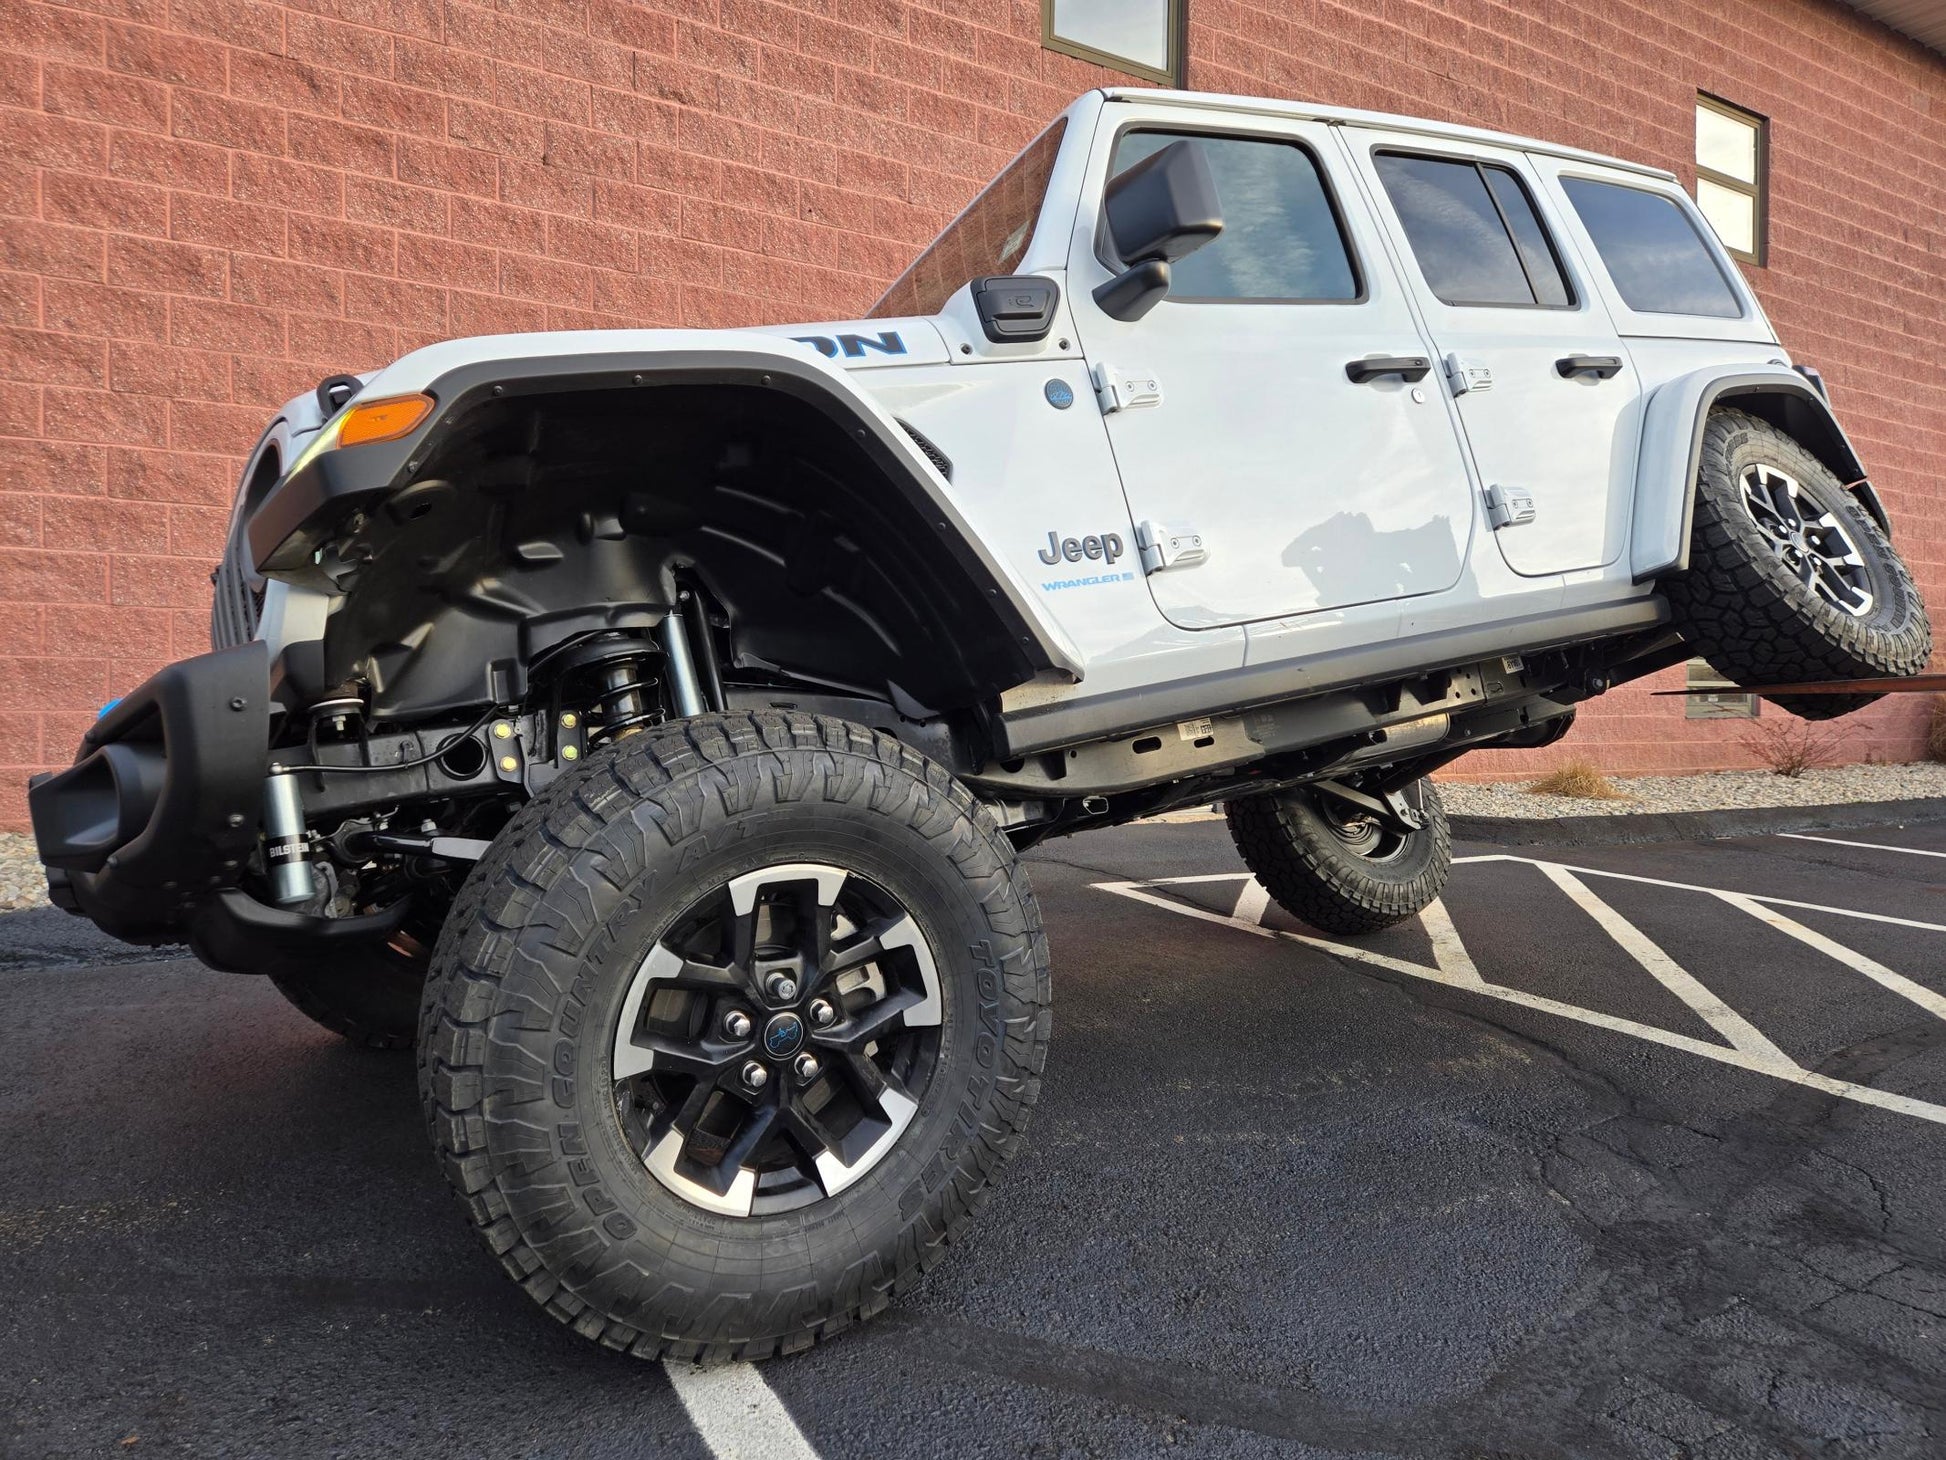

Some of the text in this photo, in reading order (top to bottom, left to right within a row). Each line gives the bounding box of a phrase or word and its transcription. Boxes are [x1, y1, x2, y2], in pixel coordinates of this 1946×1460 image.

[1038, 531, 1124, 565] Jeep
[1042, 574, 1120, 591] WRANGLER
[269, 842, 310, 858] BILSTEIN
[552, 869, 659, 1109] COUNTRY
[898, 939, 1000, 1222] TOYO TIRES
[557, 1122, 638, 1241] OPEN
